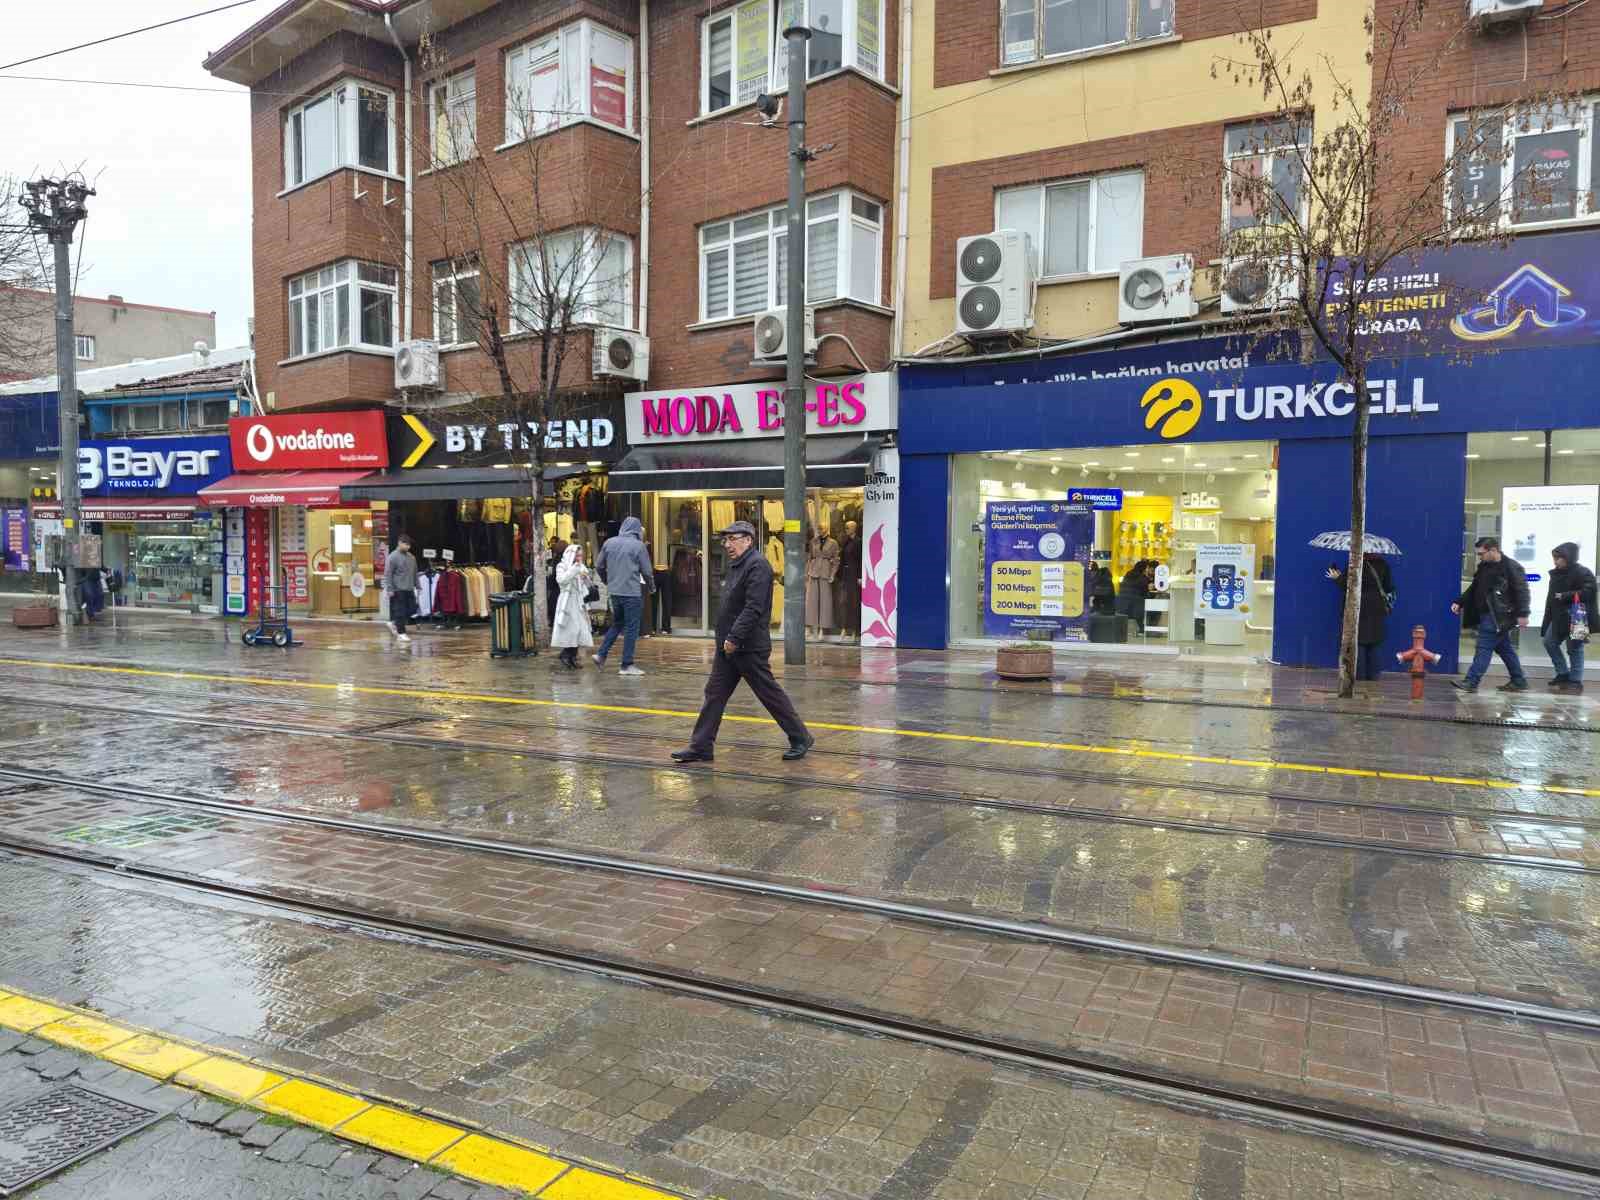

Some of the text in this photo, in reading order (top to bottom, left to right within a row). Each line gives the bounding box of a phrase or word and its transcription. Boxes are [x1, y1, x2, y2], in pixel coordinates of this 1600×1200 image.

[1332, 277, 1388, 296] SPER
[1347, 317, 1421, 335] URADA
[1208, 378, 1438, 421] TURKCELL
[641, 382, 866, 438] MODA E-ES
[275, 428, 356, 450] vodafone
[445, 425, 487, 452] BY
[106, 446, 220, 489] Bayar
[865, 475, 895, 486] Bayan
[256, 494, 285, 503] vodafone
[85, 511, 105, 520] BAYAR
[1008, 568, 1032, 576] Mbps
[1012, 584, 1035, 592] Mbps
[1014, 601, 1037, 610] Mbps
